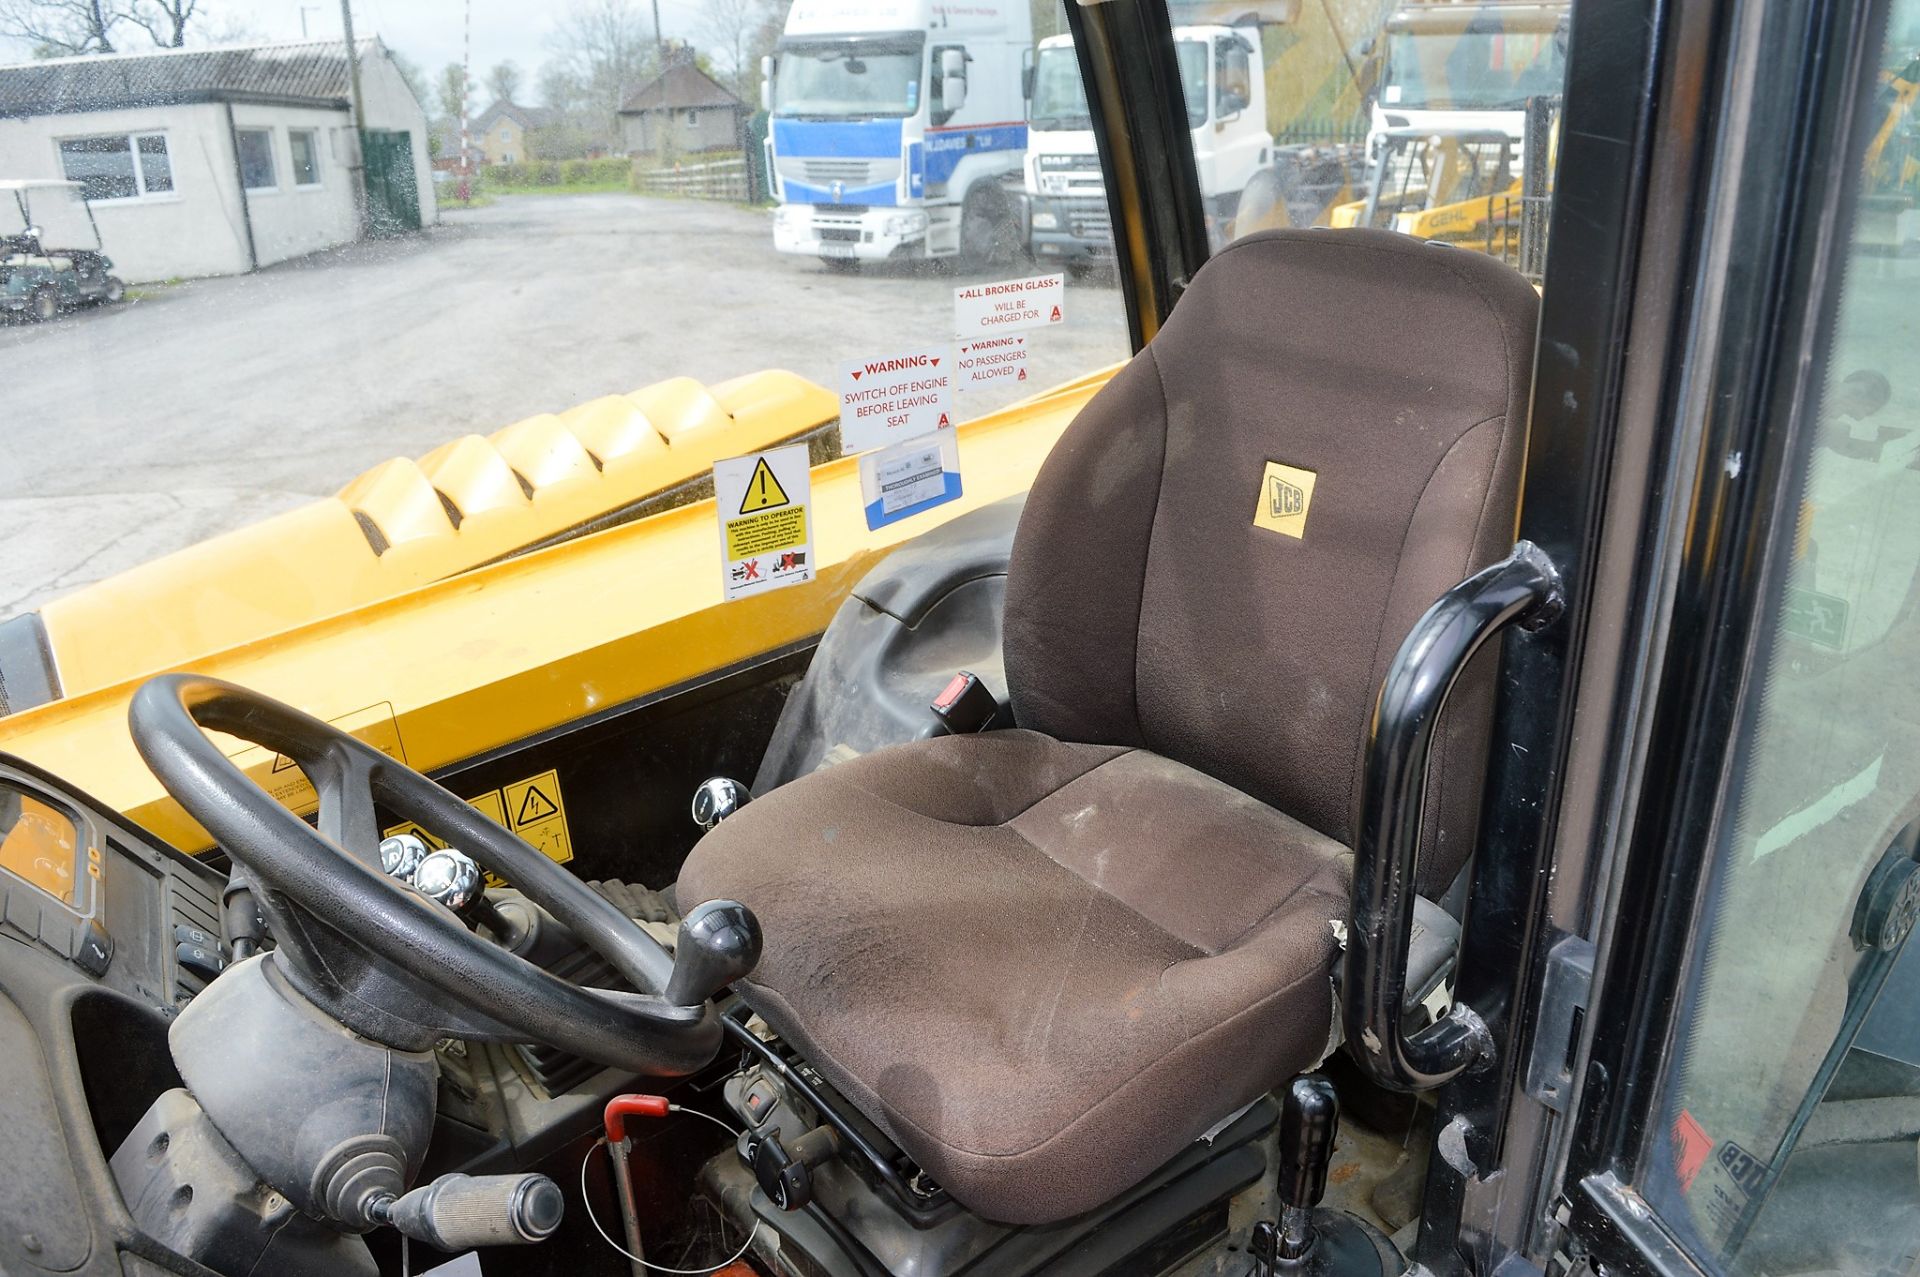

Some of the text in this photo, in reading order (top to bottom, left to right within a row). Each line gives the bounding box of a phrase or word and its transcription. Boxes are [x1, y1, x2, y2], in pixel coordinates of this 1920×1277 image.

[1430, 208, 1468, 228] GEHL
[966, 279, 1054, 298] ALL BROKEN GLASS
[994, 300, 1026, 311] WILL BE
[980, 310, 1040, 326] CHARGED FOR
[972, 338, 1014, 350] WARNING
[865, 355, 927, 374] WARNING
[958, 350, 1027, 369] NO PASSENGERS
[972, 366, 1014, 380] ALLOWED
[845, 376, 948, 404] SWITCH OFF ENGINE
[857, 394, 938, 418] BEFORE LEAVING
[887, 414, 910, 428] SEAT
[1273, 482, 1301, 514] JCB
[728, 516, 758, 528] WARNING
[770, 508, 803, 518] OPERATOR
